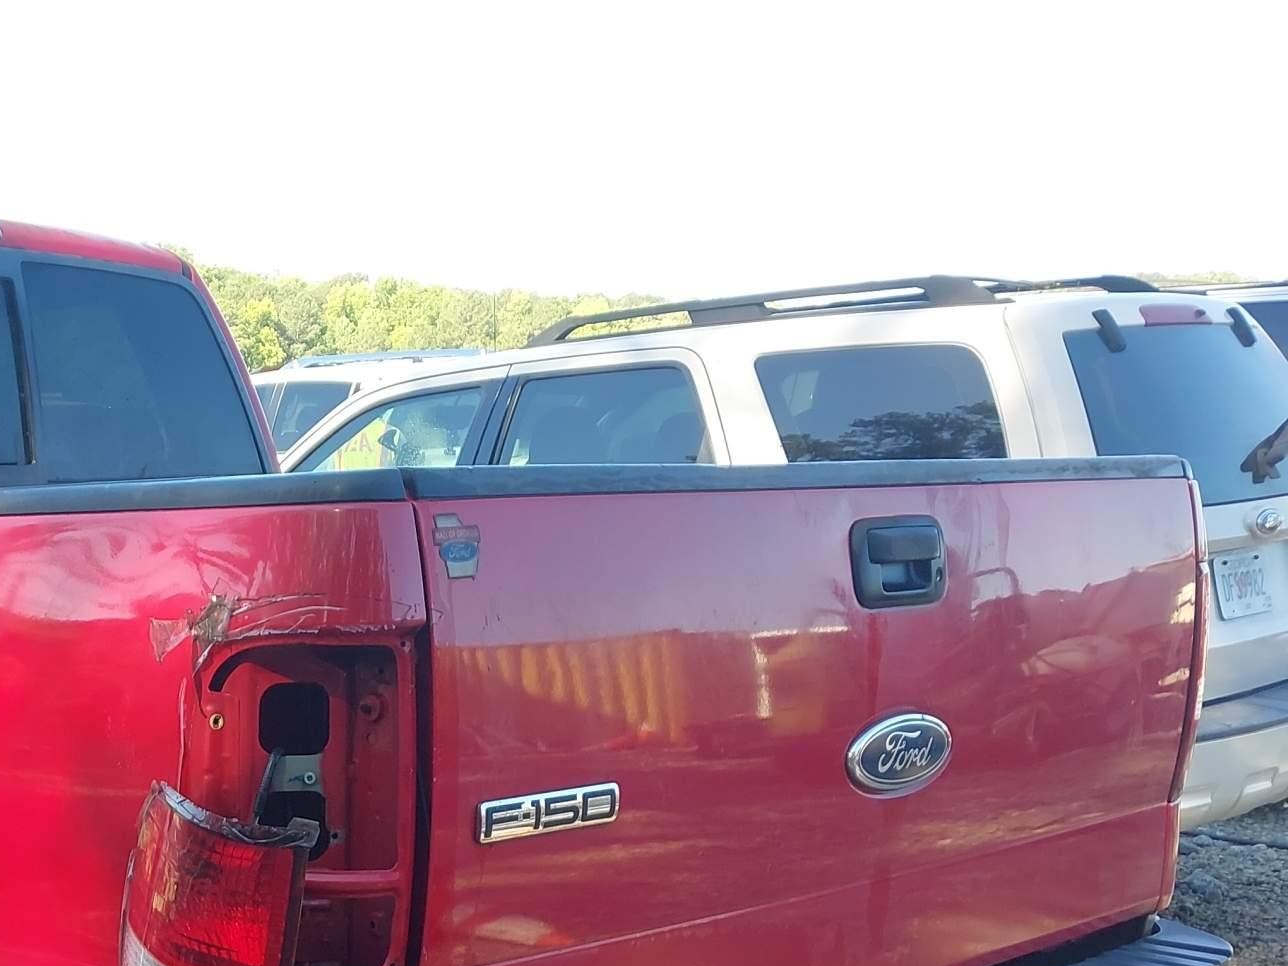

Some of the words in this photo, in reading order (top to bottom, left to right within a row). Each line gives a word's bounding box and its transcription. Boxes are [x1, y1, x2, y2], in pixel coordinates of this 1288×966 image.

[448, 544, 471, 558] Ford
[879, 731, 933, 773] Ford
[483, 788, 617, 838] F-150
